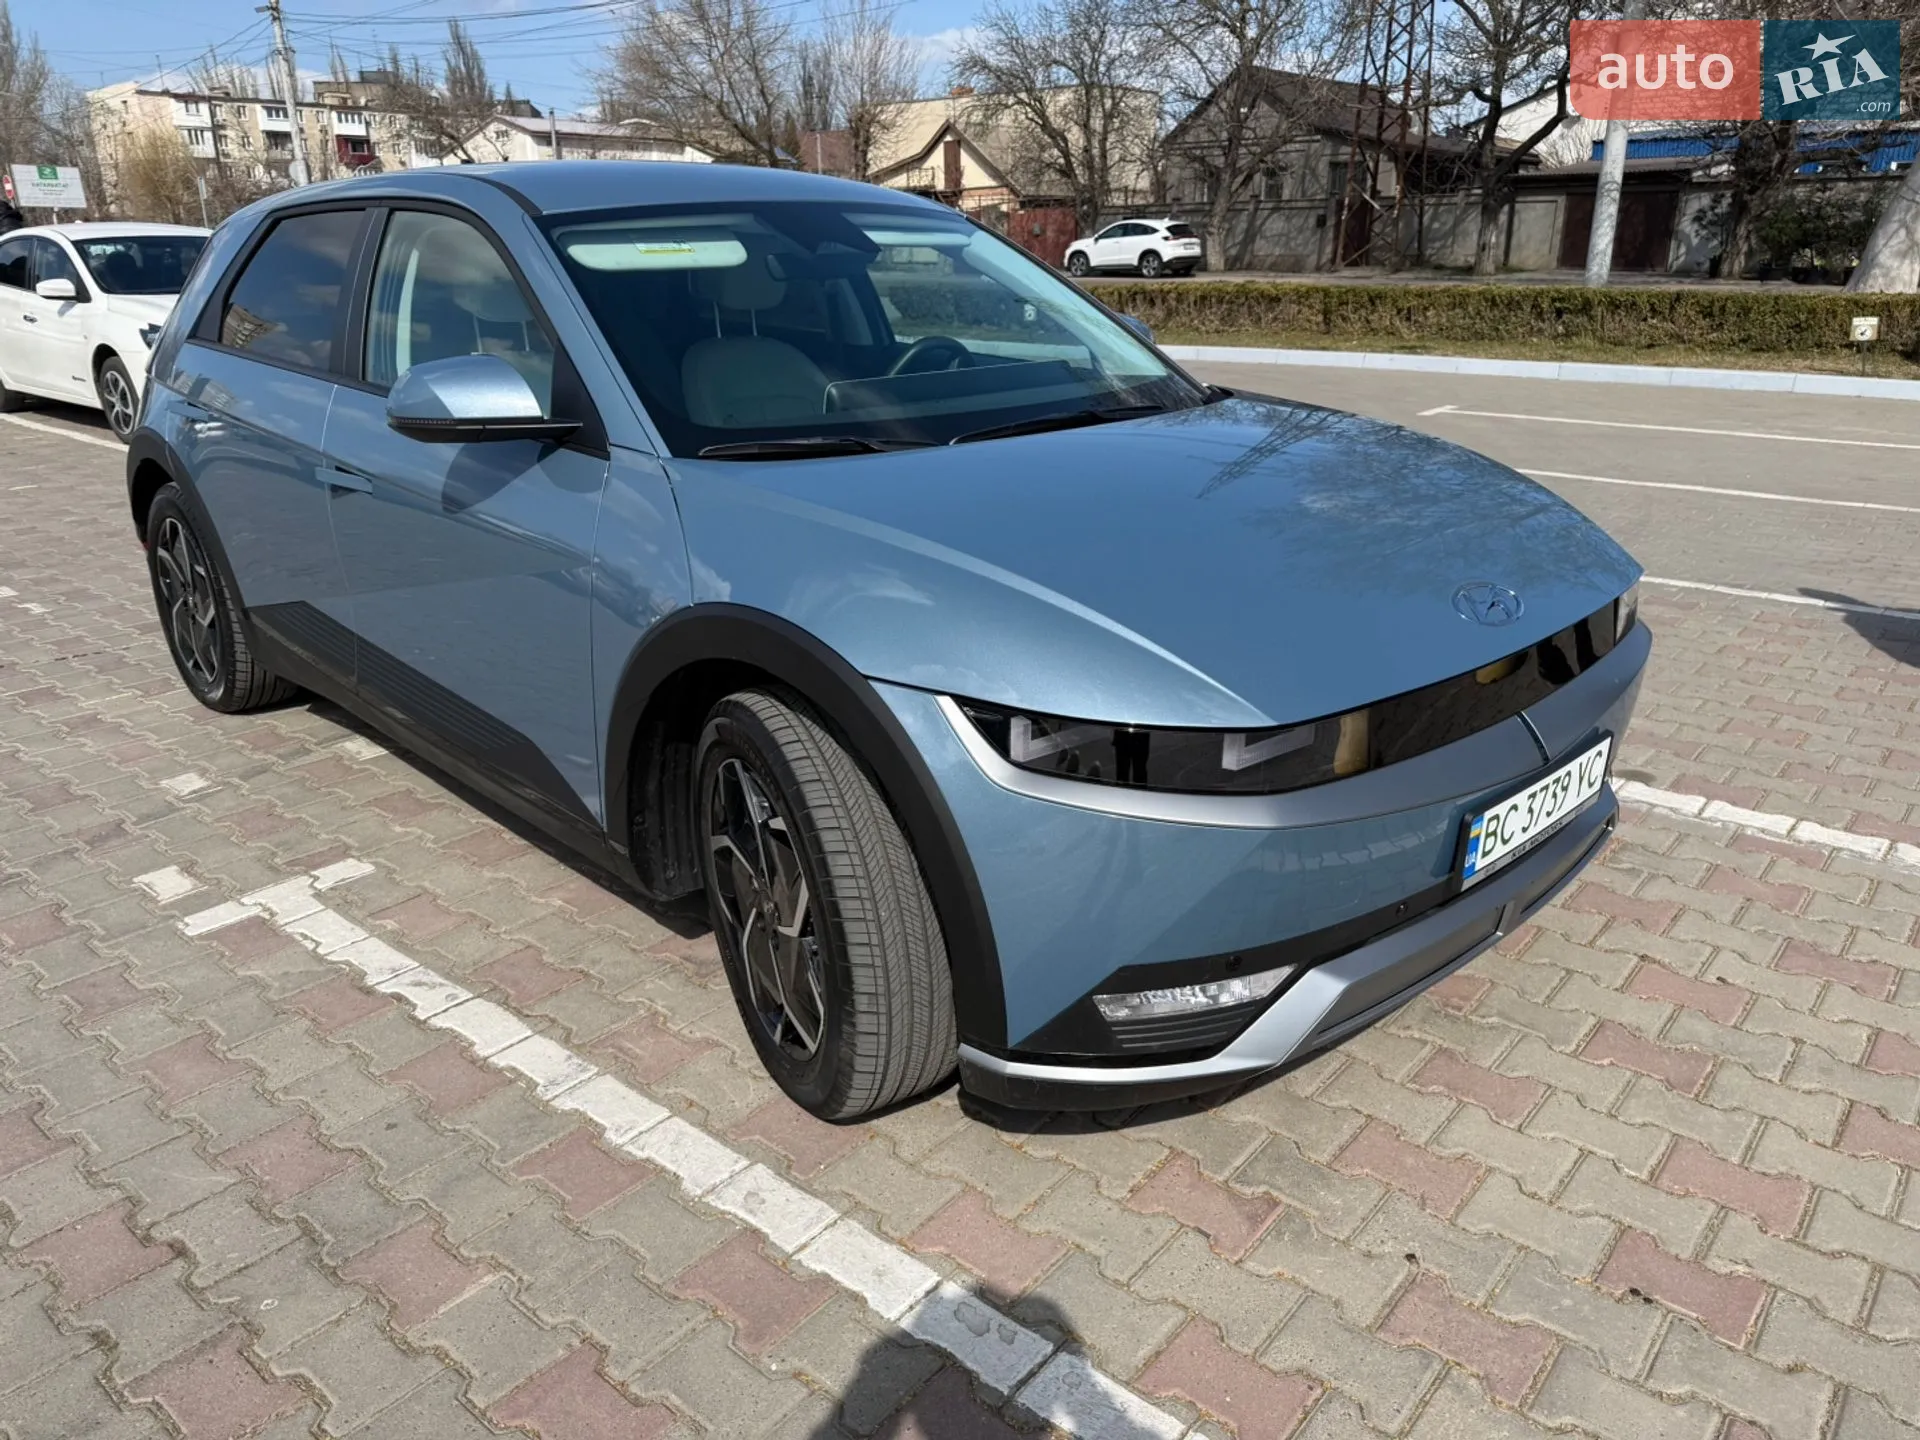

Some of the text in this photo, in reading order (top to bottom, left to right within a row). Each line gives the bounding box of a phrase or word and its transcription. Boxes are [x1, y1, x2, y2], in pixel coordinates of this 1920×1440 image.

[1481, 804, 1519, 859] BC
[1521, 770, 1572, 834] 3739
[1576, 749, 1603, 798] YC
